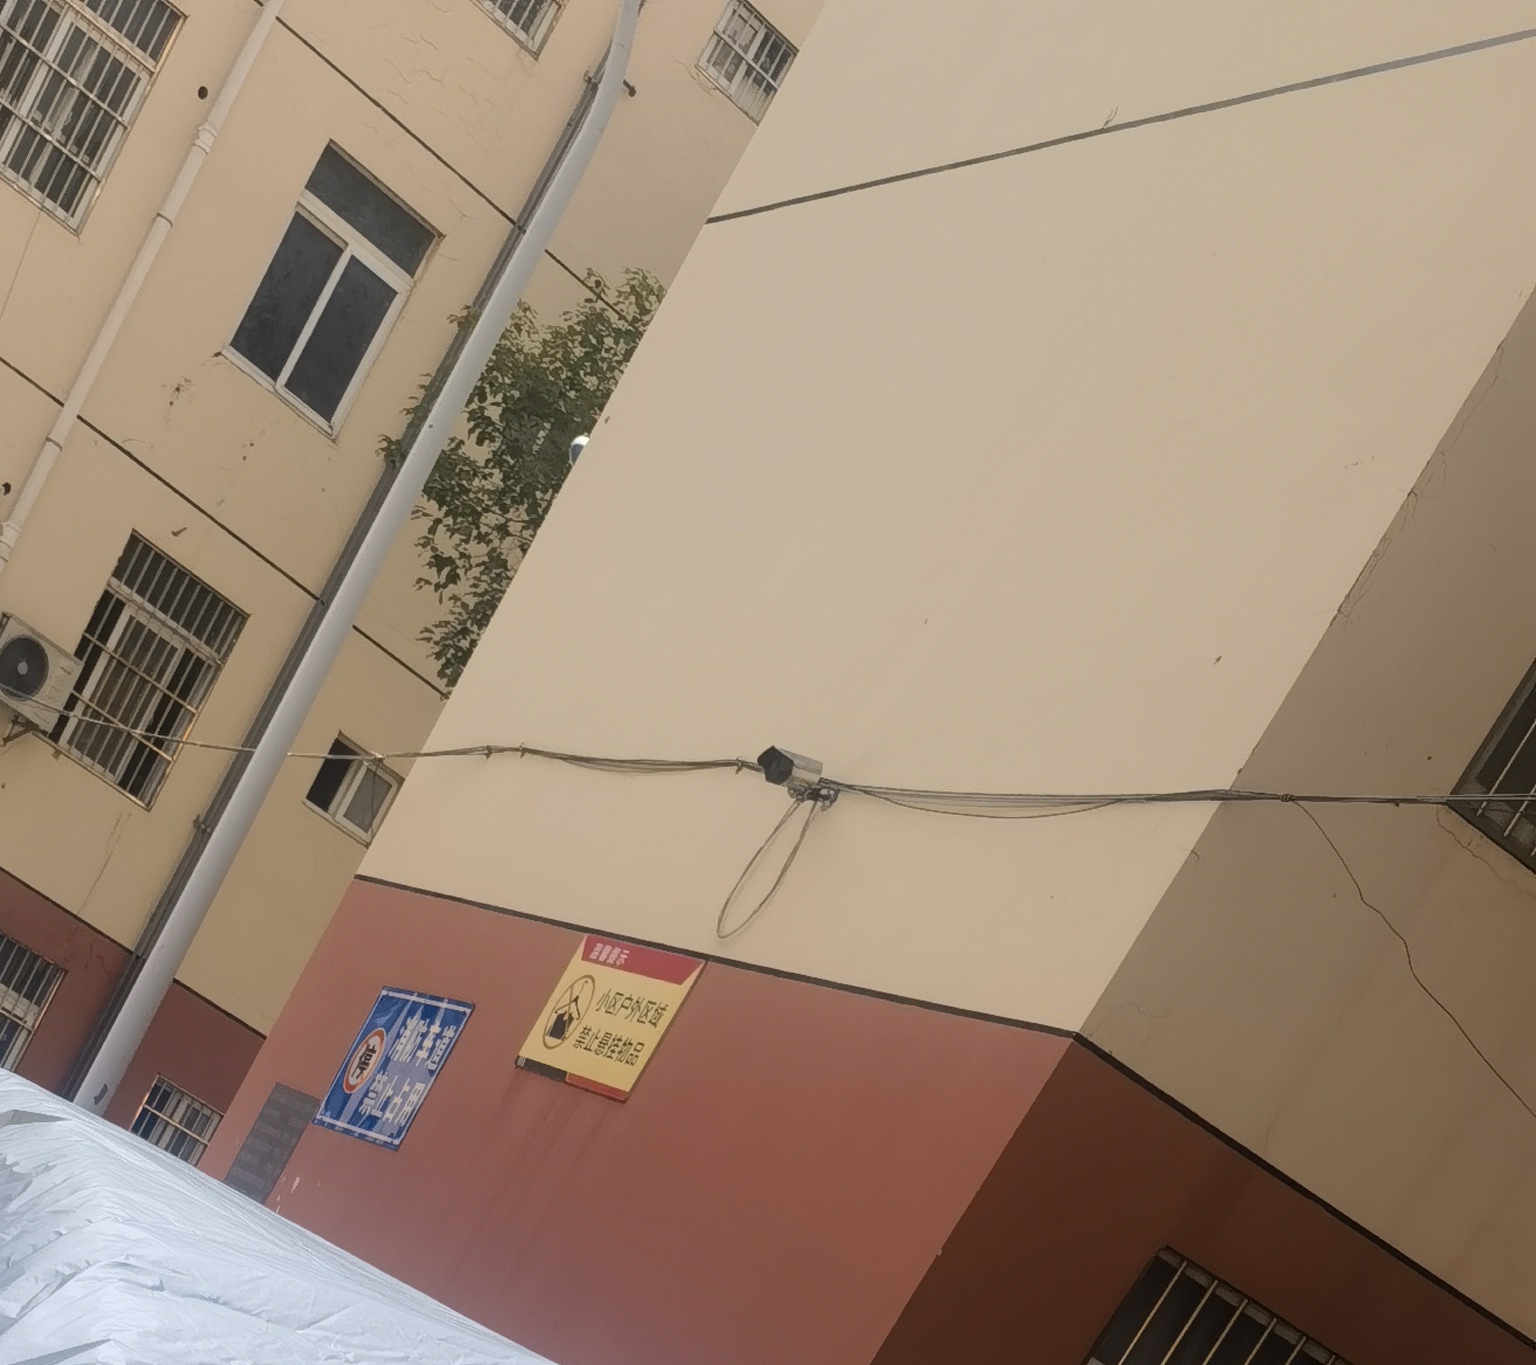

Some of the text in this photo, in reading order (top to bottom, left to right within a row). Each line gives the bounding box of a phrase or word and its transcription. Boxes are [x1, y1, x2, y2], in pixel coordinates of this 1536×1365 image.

[595, 988, 669, 1029] 小区户外区域
[388, 1016, 457, 1070] 消防车道
[572, 1025, 645, 1066] 禁止悬挂物品
[358, 1069, 426, 1127] 禁止占用
